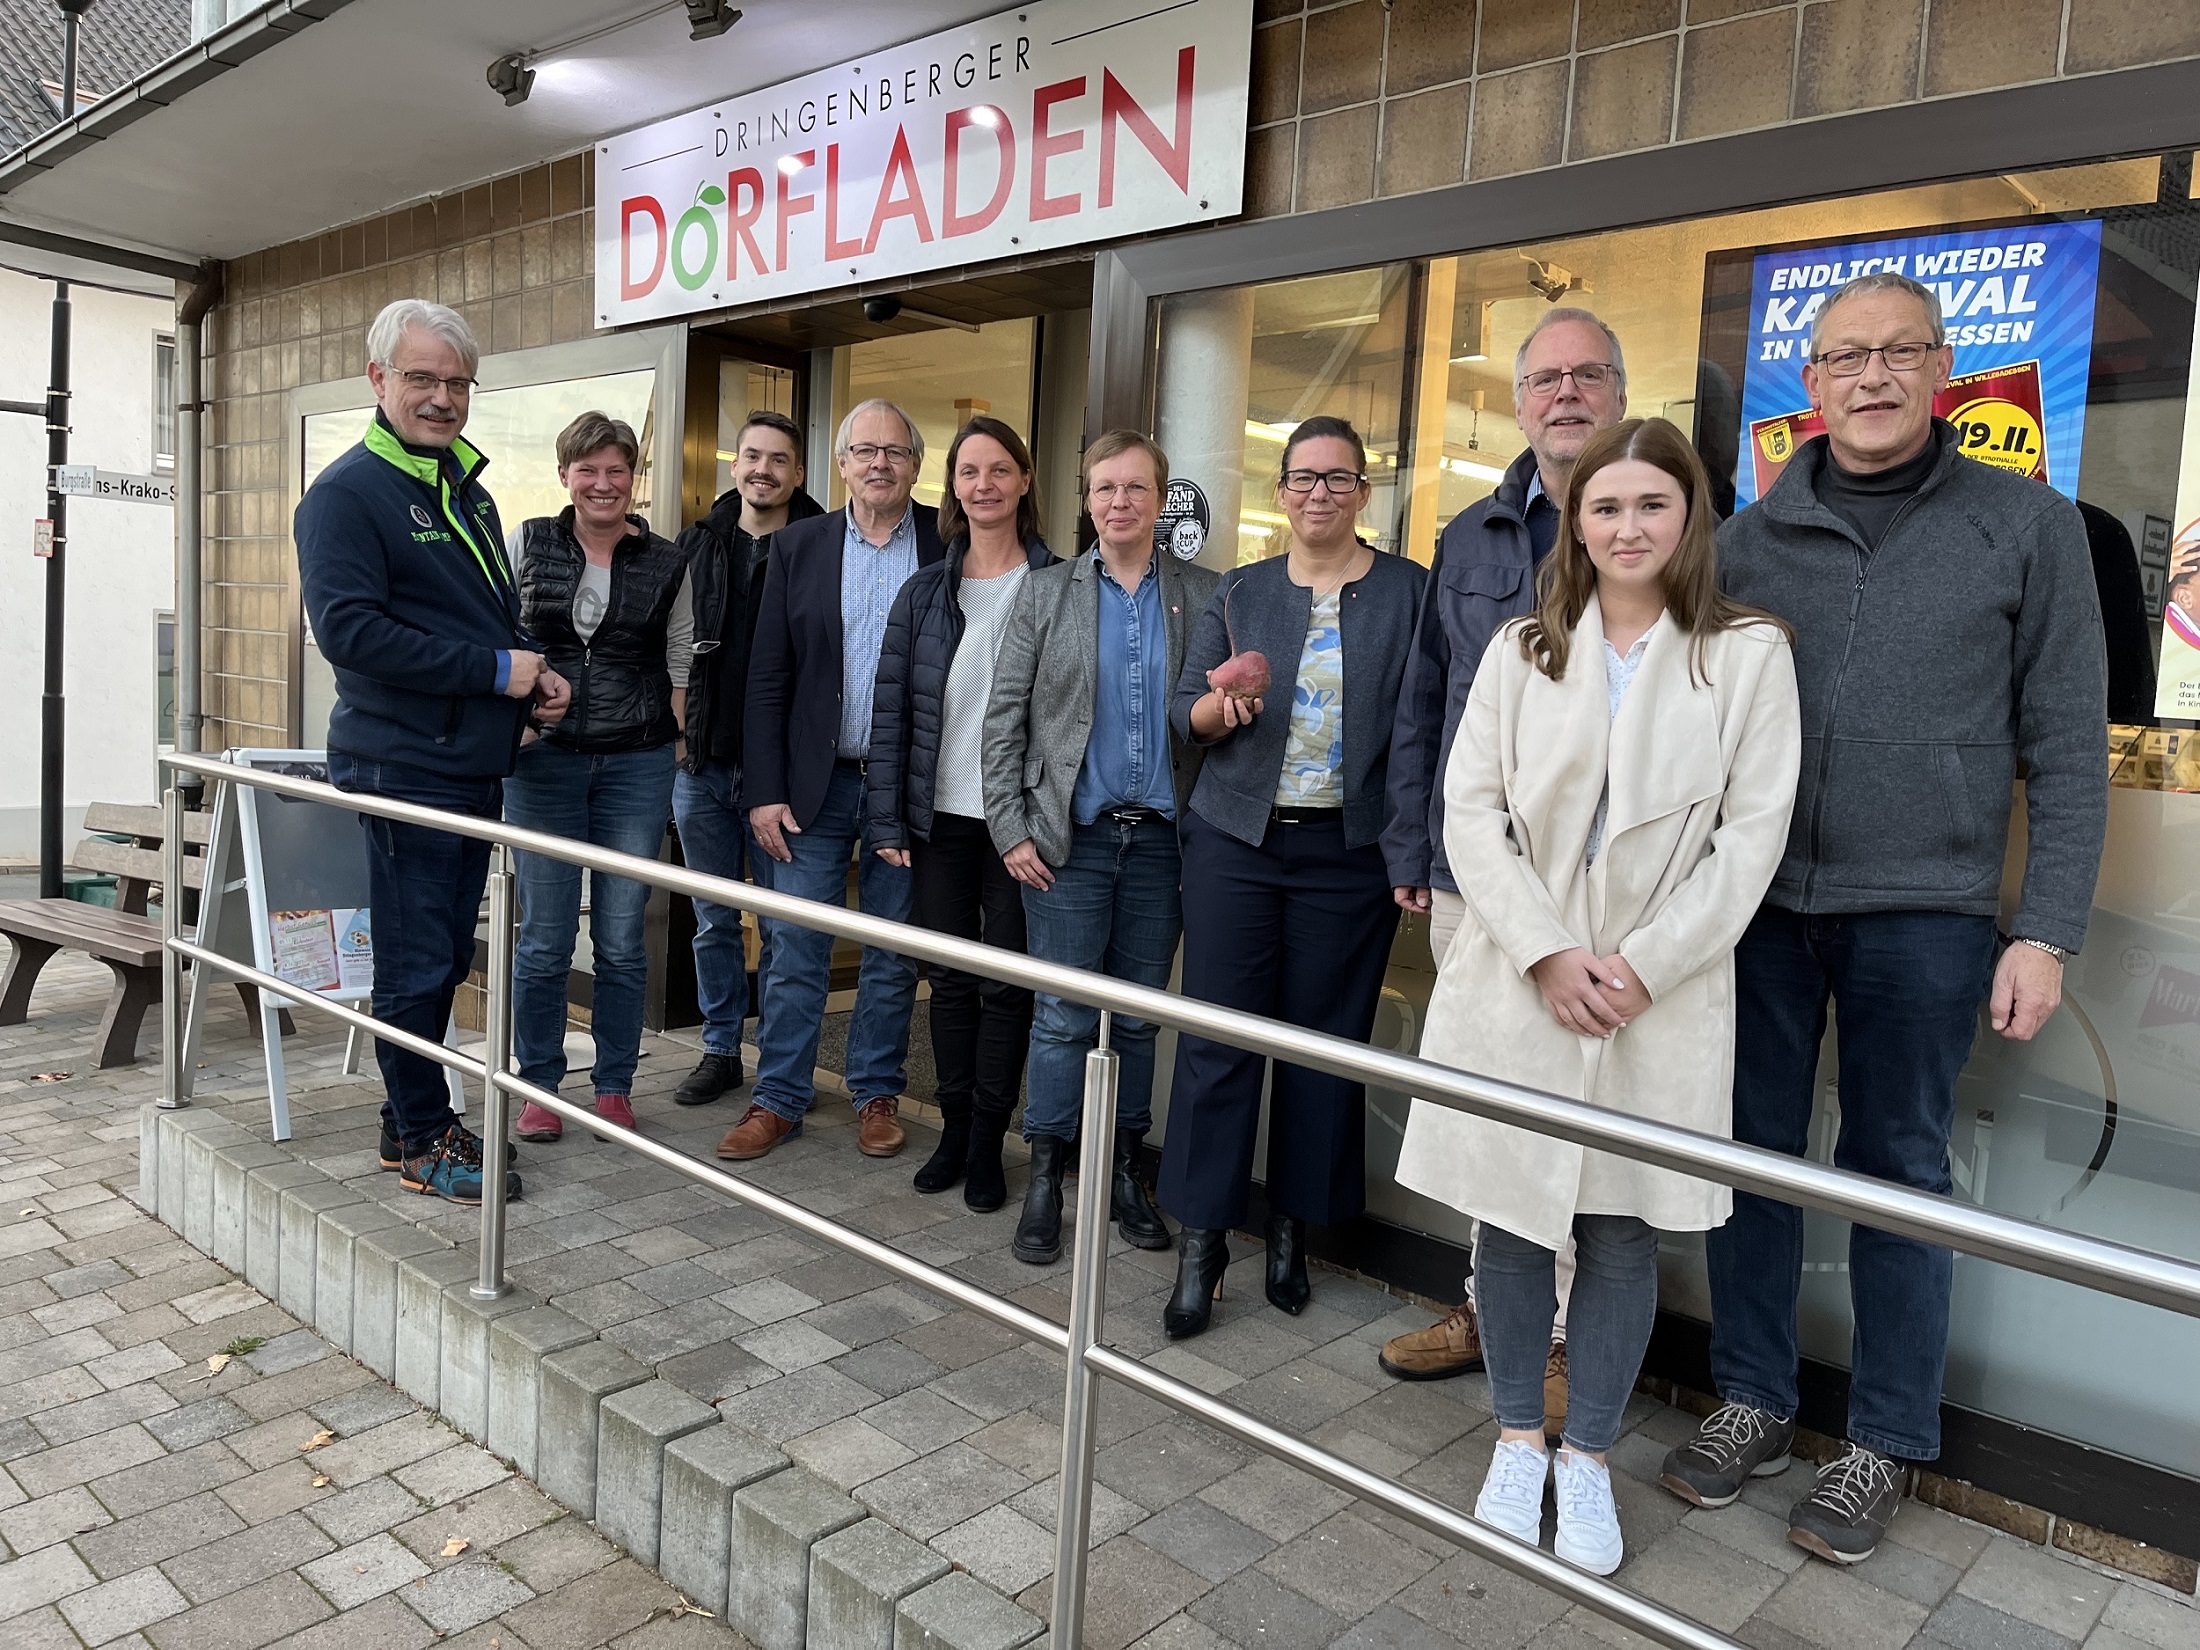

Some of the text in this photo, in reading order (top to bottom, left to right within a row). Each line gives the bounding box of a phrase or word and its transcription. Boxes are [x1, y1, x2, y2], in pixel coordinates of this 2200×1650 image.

[715, 37, 1031, 158] DRINGENBERGER
[621, 45, 1197, 302] DORFLADEN
[1769, 242, 2047, 291] ENDLICH WIEDER
[1762, 274, 2037, 333] KAVAL
[1760, 339, 1794, 361] IN
[1797, 411, 1817, 421] TROTZ
[61, 470, 91, 492] Burgstraße
[1167, 490, 1195, 503] FAND
[1162, 501, 1195, 512] ECHER
[1179, 530, 1198, 540] back
[1179, 539, 1194, 547] CUP
[2179, 681, 2195, 689] Der
